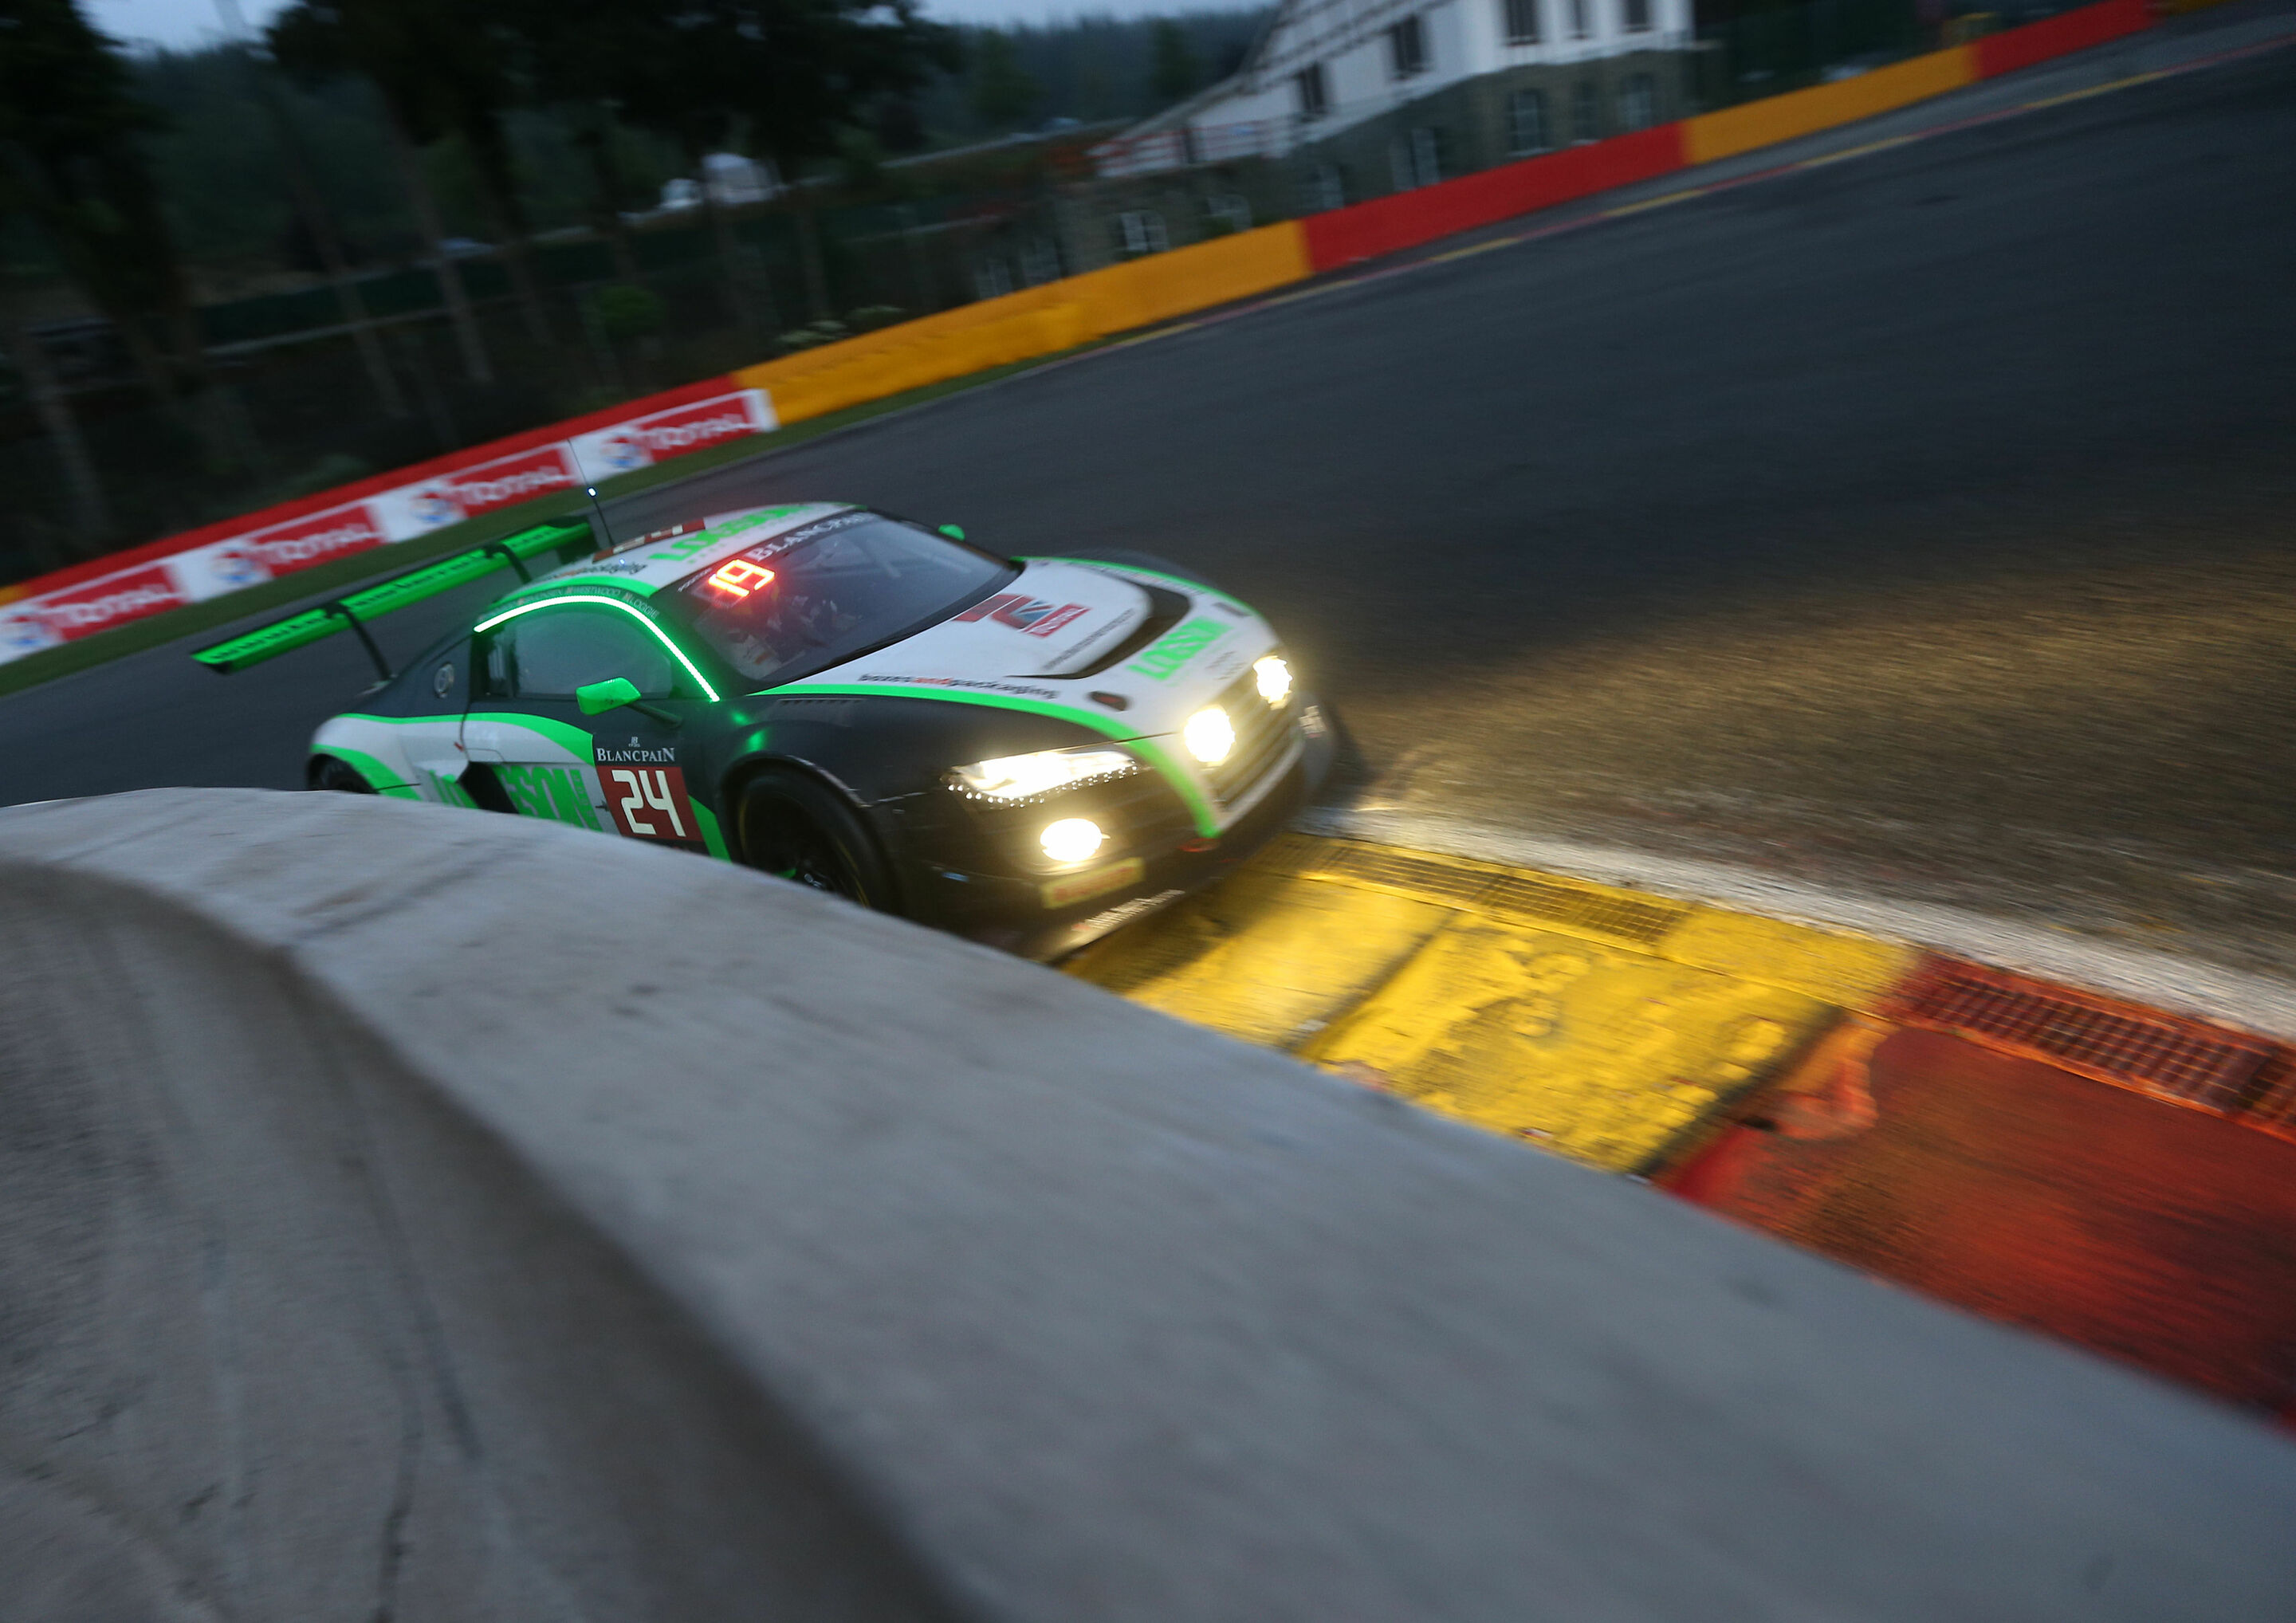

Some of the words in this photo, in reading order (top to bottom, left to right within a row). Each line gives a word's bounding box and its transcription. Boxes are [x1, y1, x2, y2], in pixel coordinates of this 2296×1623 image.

[708, 559, 776, 597] 19
[596, 748, 675, 762] BLANCPAIN
[611, 769, 686, 837] 24
